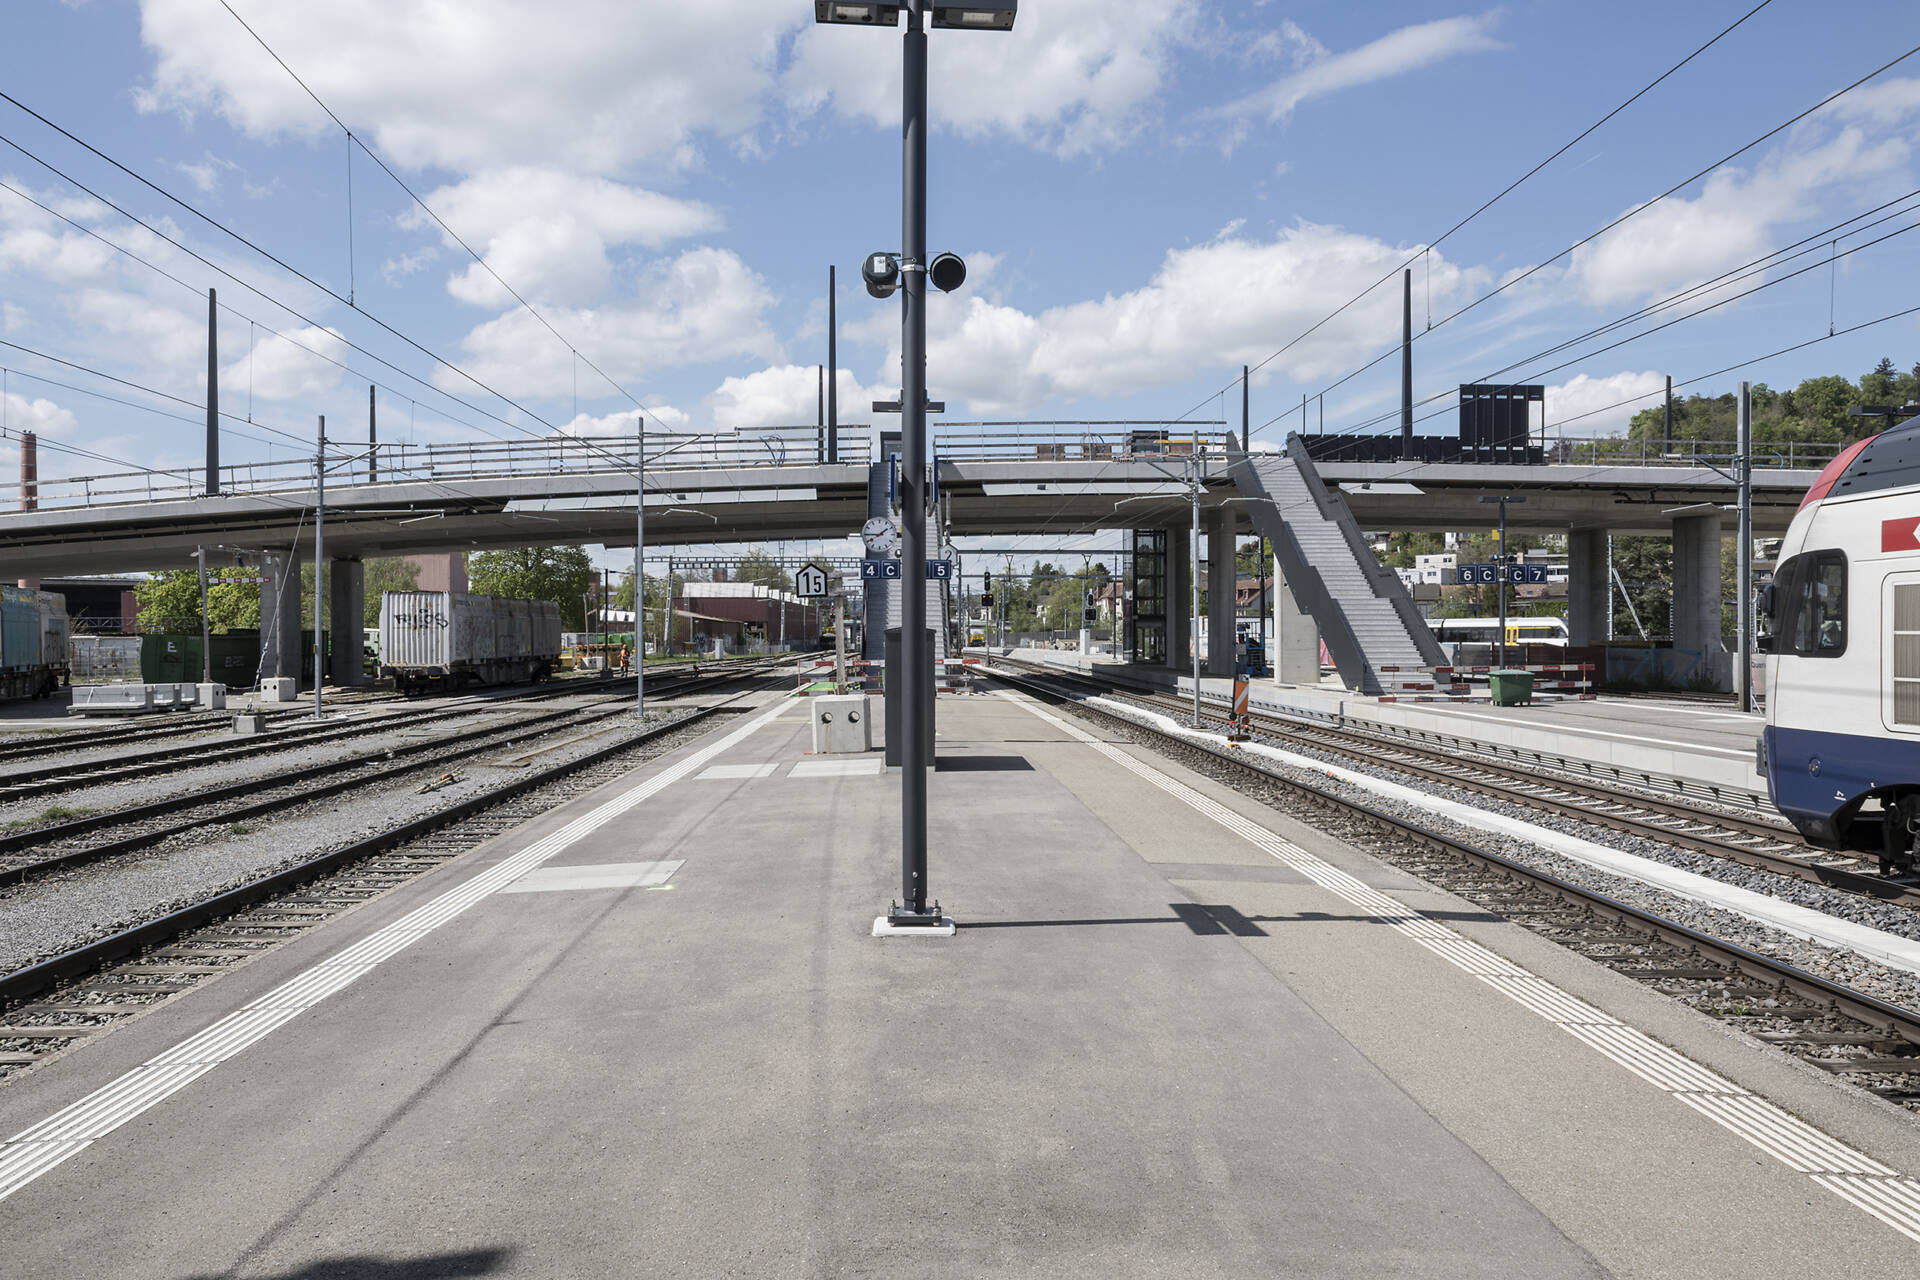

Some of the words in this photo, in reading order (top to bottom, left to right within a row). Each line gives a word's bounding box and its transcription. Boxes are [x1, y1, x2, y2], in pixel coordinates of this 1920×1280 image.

[866, 565, 875, 576] 4
[886, 565, 895, 576] C
[937, 566, 945, 576] 5
[1463, 570, 1472, 581] 6
[1483, 570, 1492, 581] C
[1513, 570, 1522, 581] C
[1533, 571, 1541, 581] 7
[802, 572, 822, 593] 15
